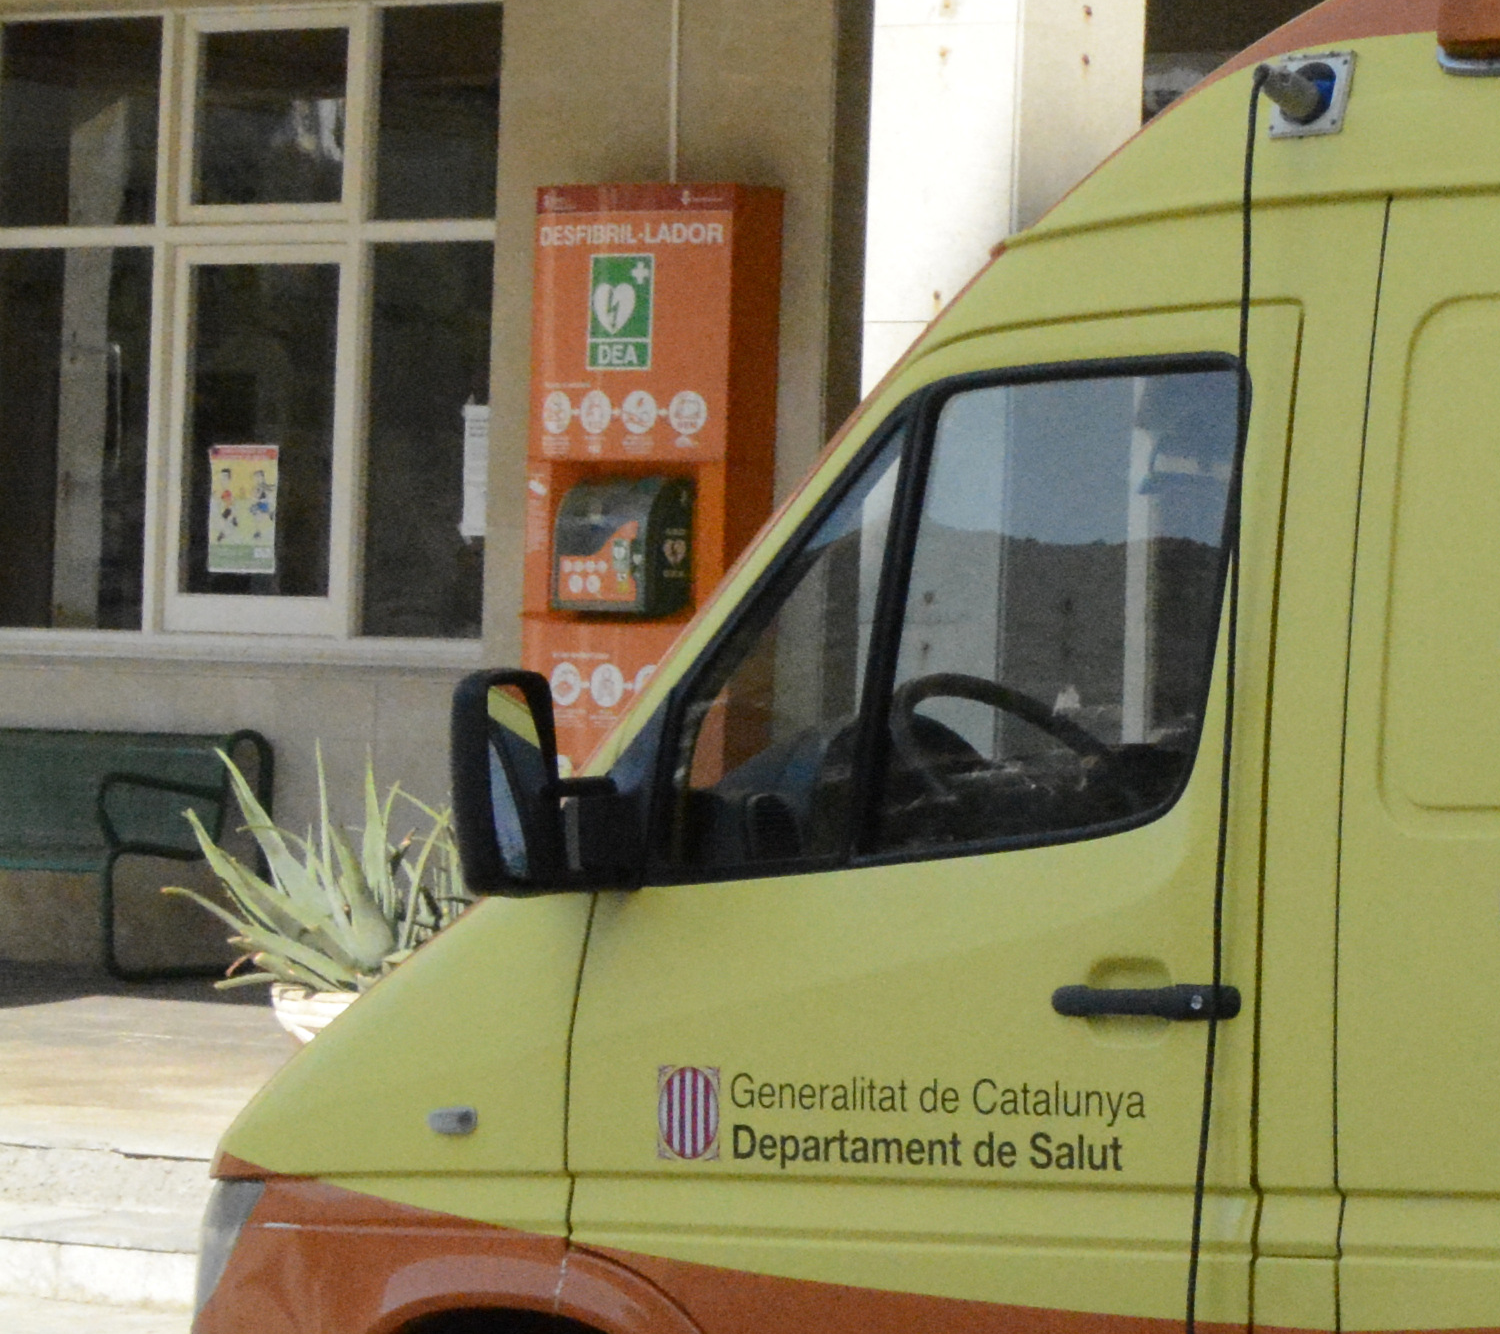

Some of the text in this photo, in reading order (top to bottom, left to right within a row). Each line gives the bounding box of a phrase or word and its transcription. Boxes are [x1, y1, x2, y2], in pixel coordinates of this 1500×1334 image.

[597, 343, 639, 366] DEA
[730, 1071, 1146, 1127] Generalitat de Catalunya
[731, 1124, 1123, 1172] Departament de Salut
